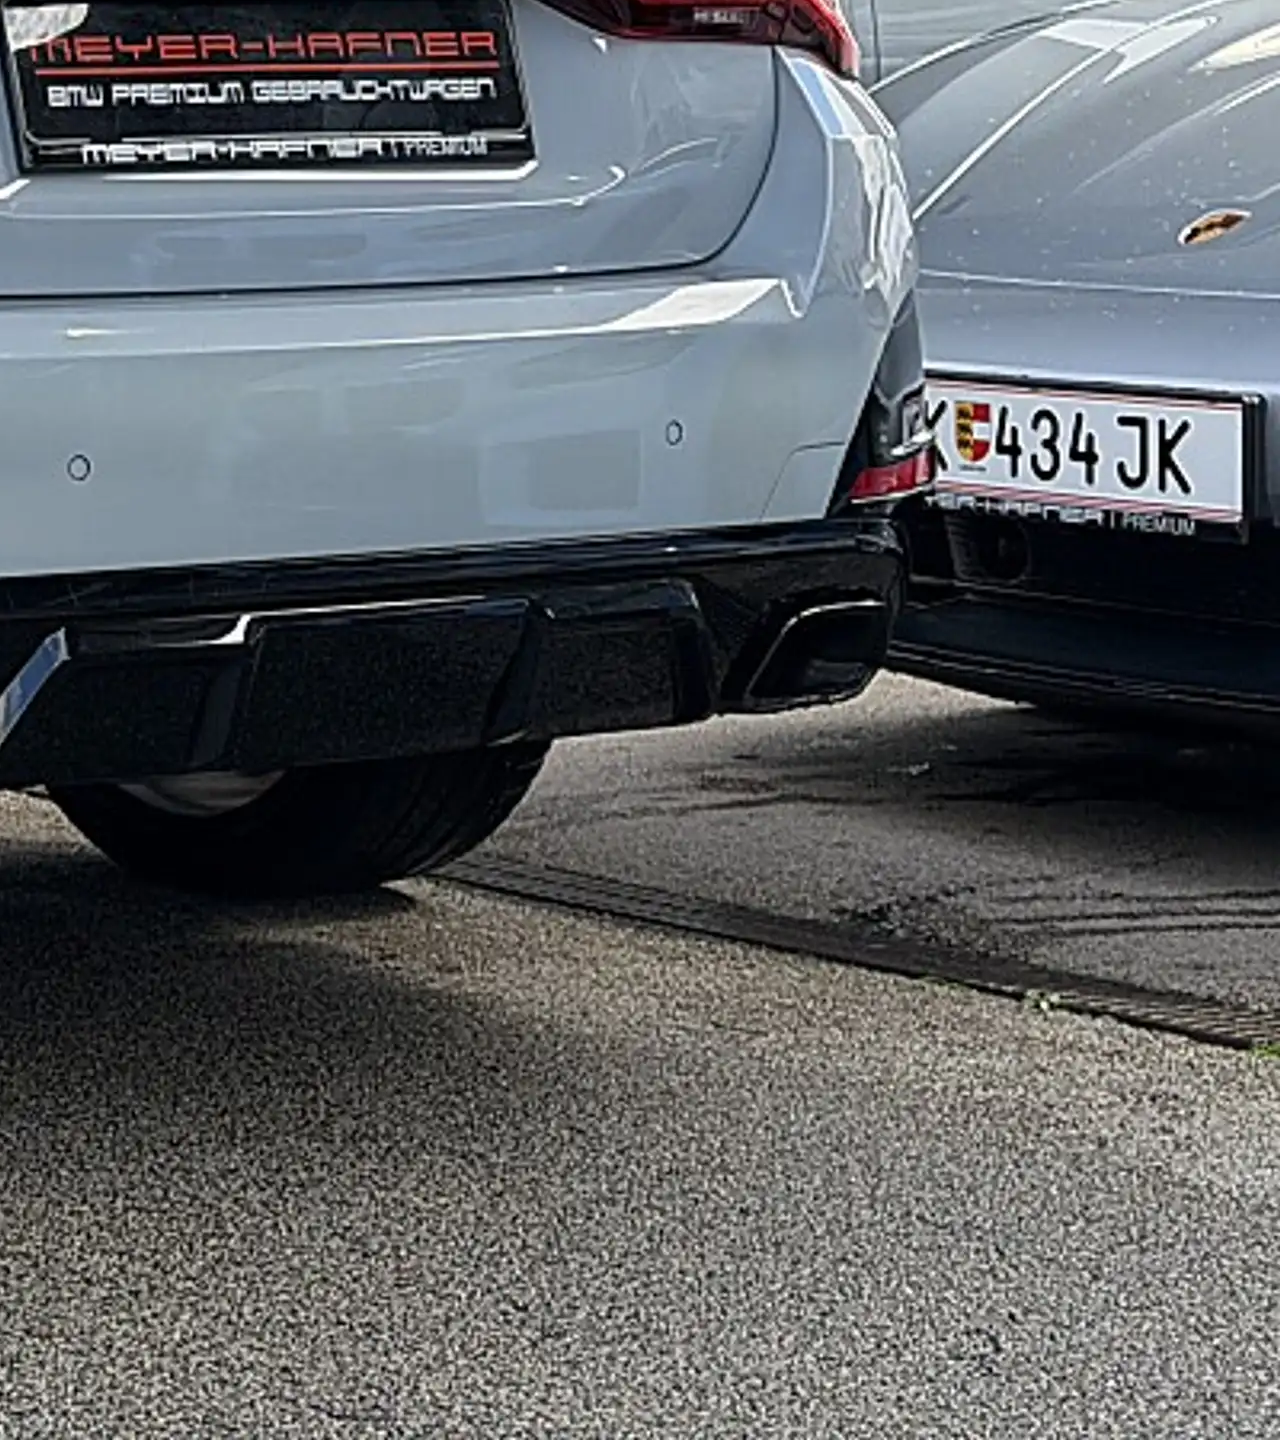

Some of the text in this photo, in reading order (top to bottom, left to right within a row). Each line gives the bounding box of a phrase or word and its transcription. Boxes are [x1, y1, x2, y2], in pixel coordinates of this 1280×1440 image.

[29, 30, 498, 63] MEYER-HAFNER
[47, 77, 498, 108] BMW PREMIUM GEBRAUCHTWAGEN
[80, 136, 489, 165] MEYER-HAFNER PREMIUM
[994, 405, 1101, 486] 434
[1116, 415, 1192, 496] JK
[923, 492, 1197, 537] YER-HAFNER PREMIUM
